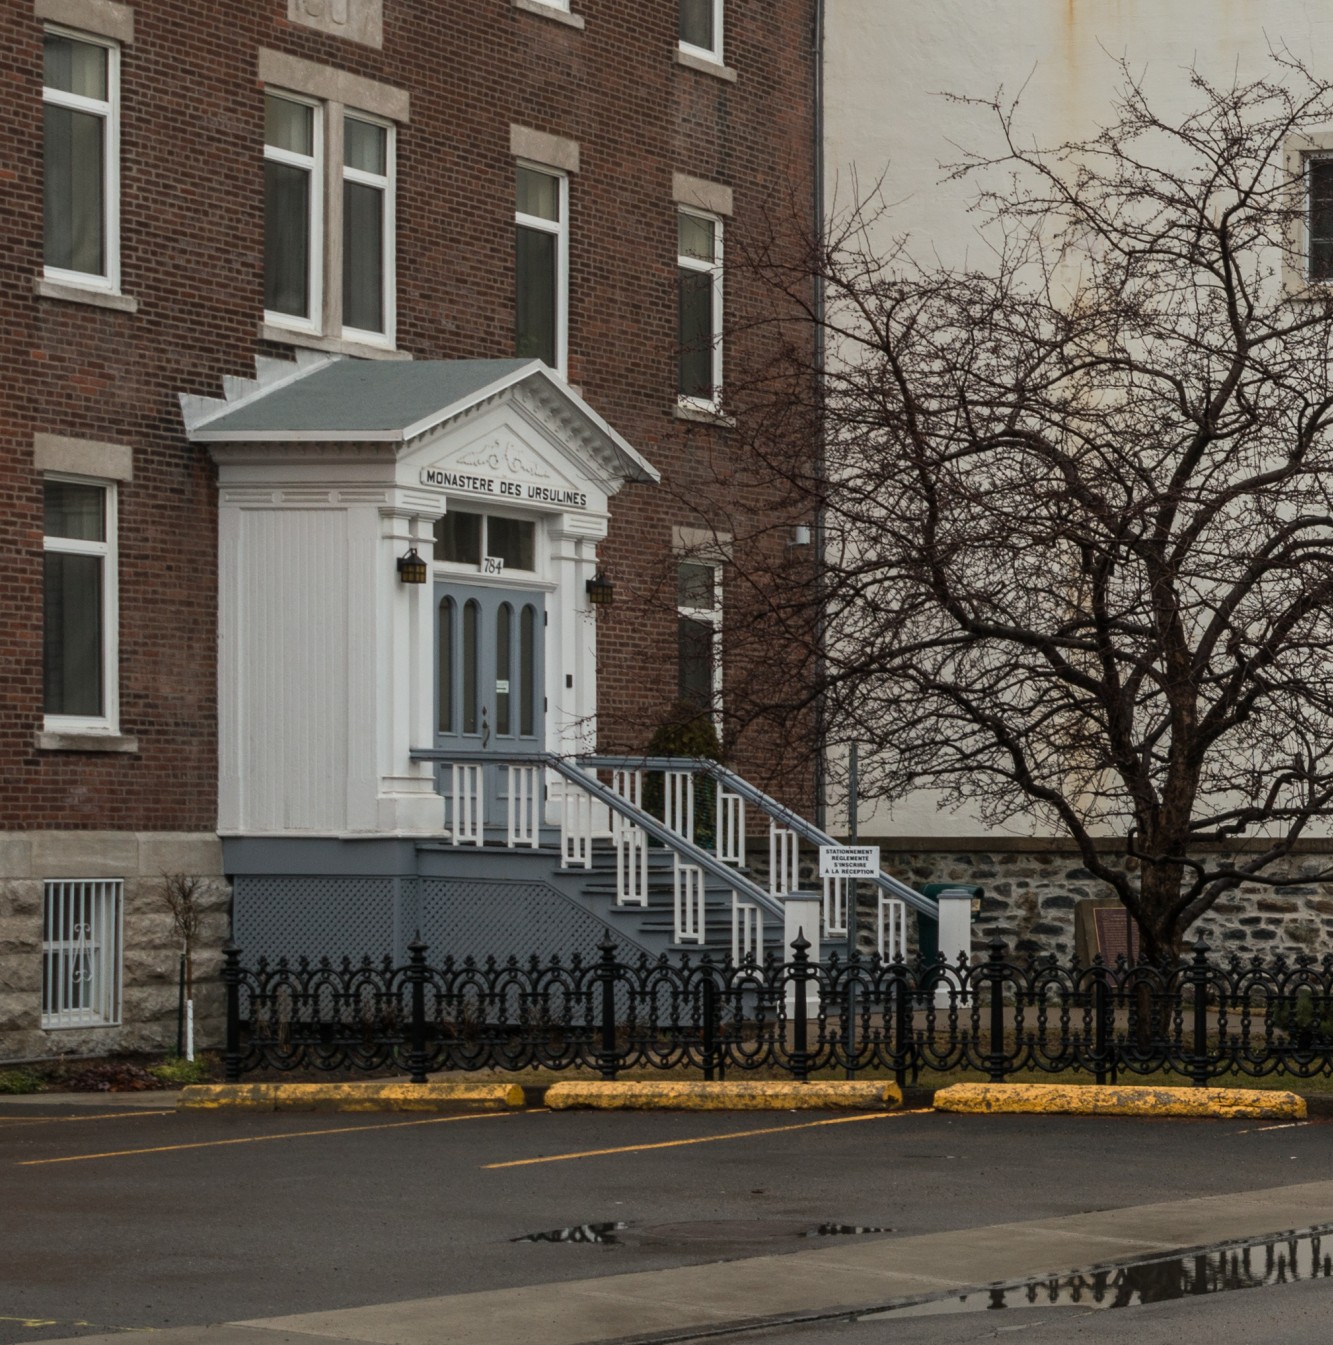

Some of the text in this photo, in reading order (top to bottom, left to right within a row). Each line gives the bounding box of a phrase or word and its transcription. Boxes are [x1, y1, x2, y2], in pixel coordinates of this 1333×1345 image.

[427, 470, 586, 505] MONASTERE DES URSULINES
[484, 558, 502, 574] 784
